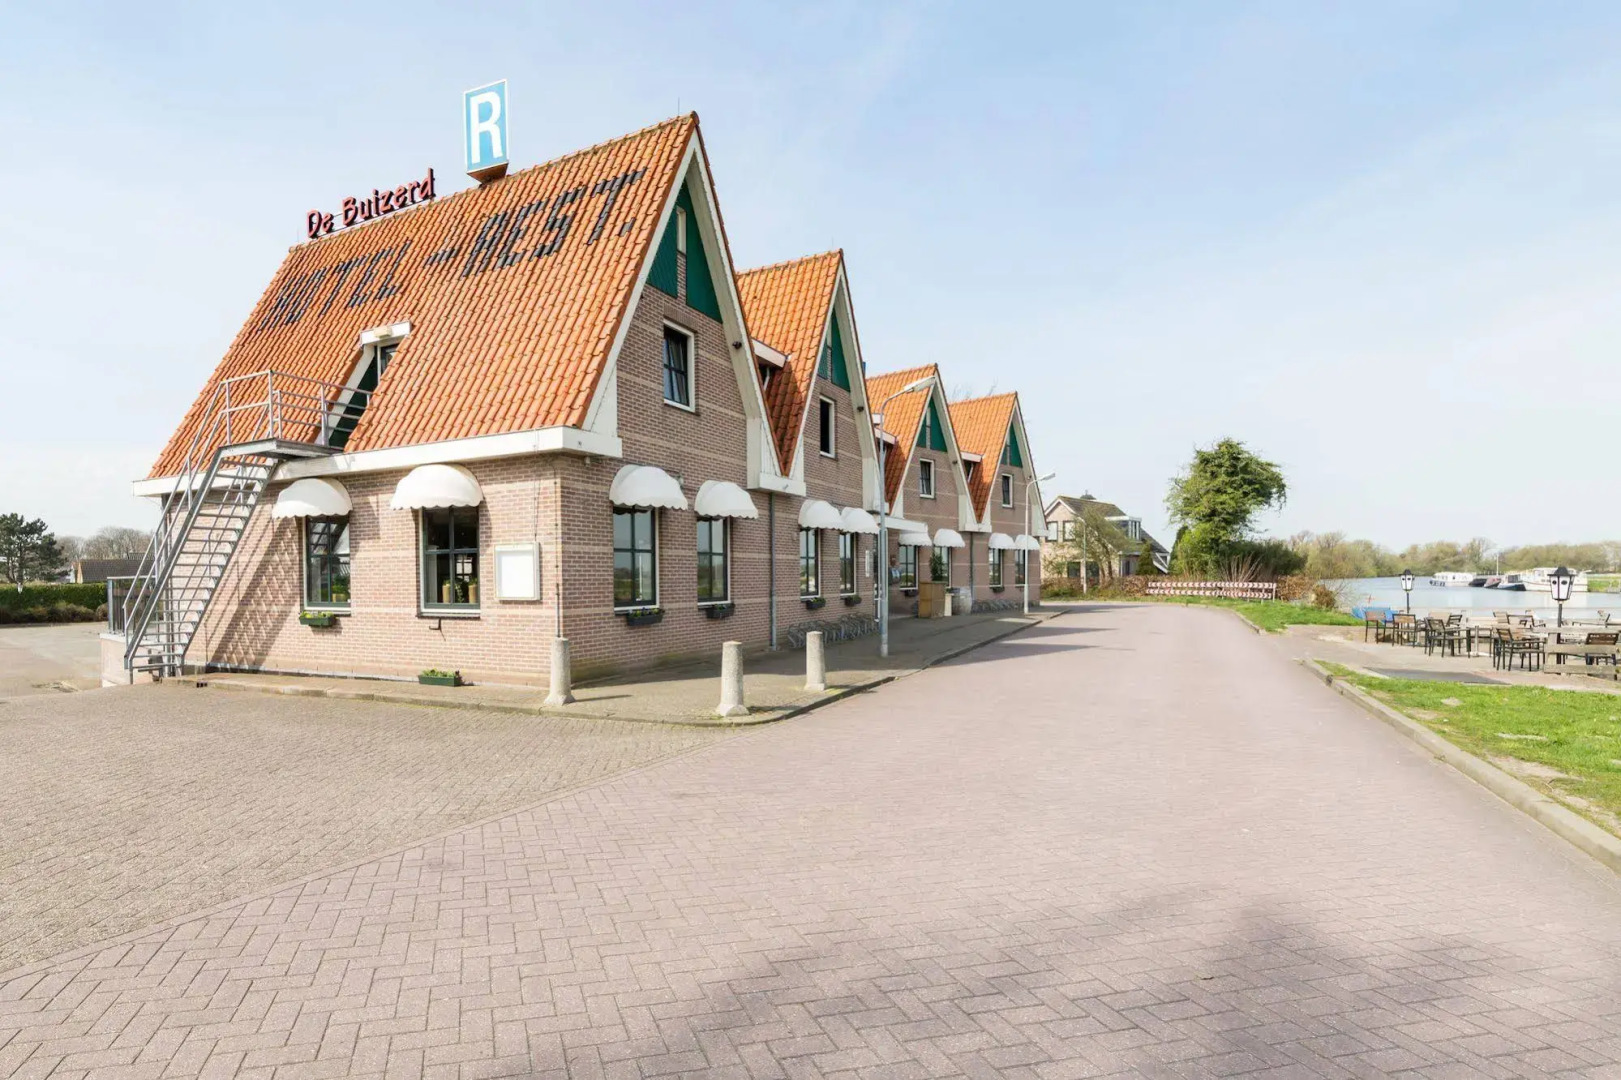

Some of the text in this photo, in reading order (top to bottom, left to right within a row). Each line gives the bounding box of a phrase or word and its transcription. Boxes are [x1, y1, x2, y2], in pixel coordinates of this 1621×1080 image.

[469, 91, 503, 164] R
[306, 167, 436, 239] De Buizerd
